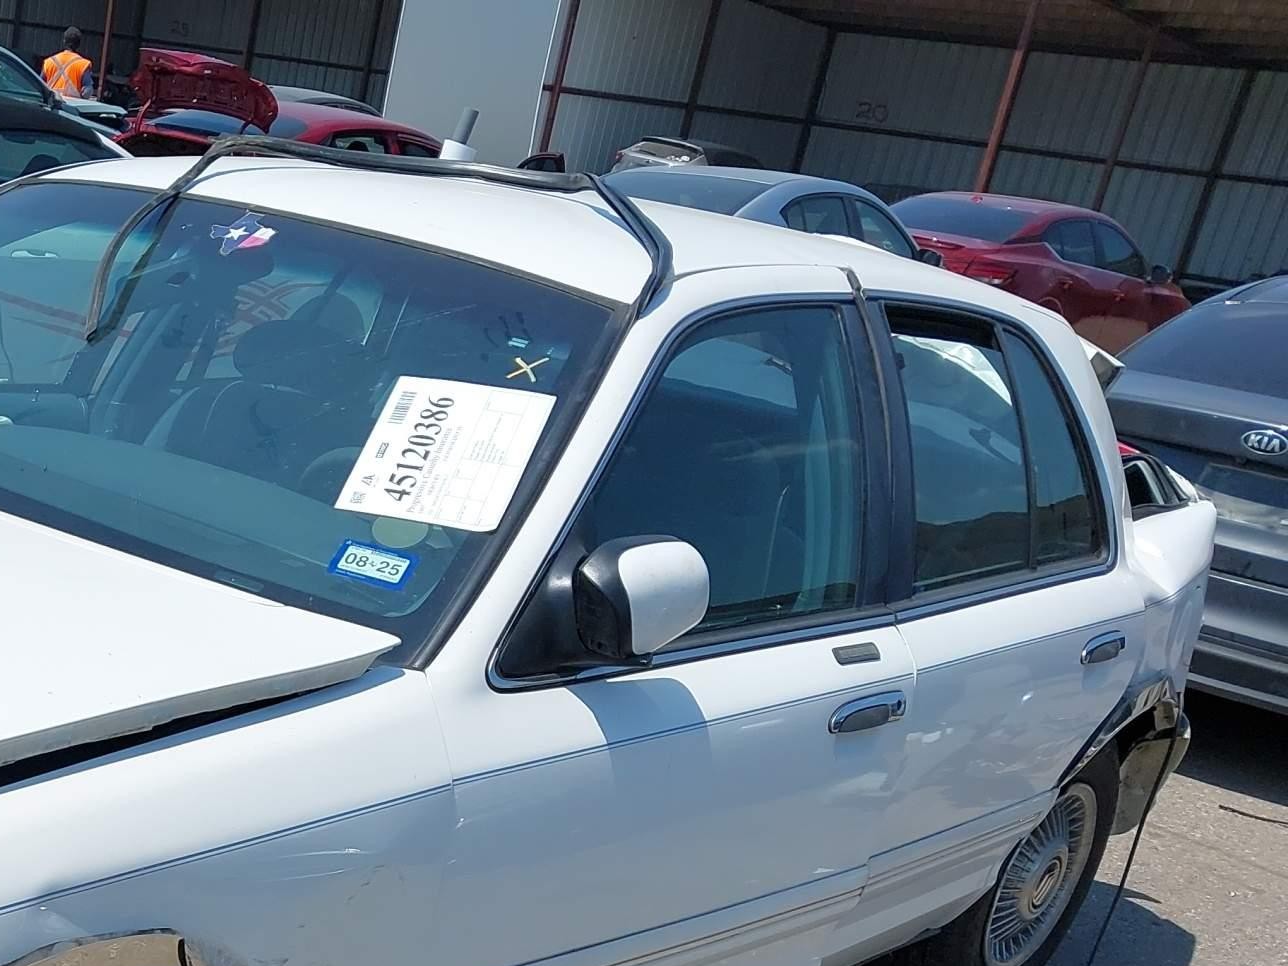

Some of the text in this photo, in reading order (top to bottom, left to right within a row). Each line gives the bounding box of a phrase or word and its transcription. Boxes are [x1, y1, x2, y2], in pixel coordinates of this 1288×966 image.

[855, 102, 889, 122] 20
[383, 394, 455, 502] 45120386
[1247, 433, 1281, 453] KIA
[344, 552, 370, 568] 08
[376, 560, 403, 577] 25
